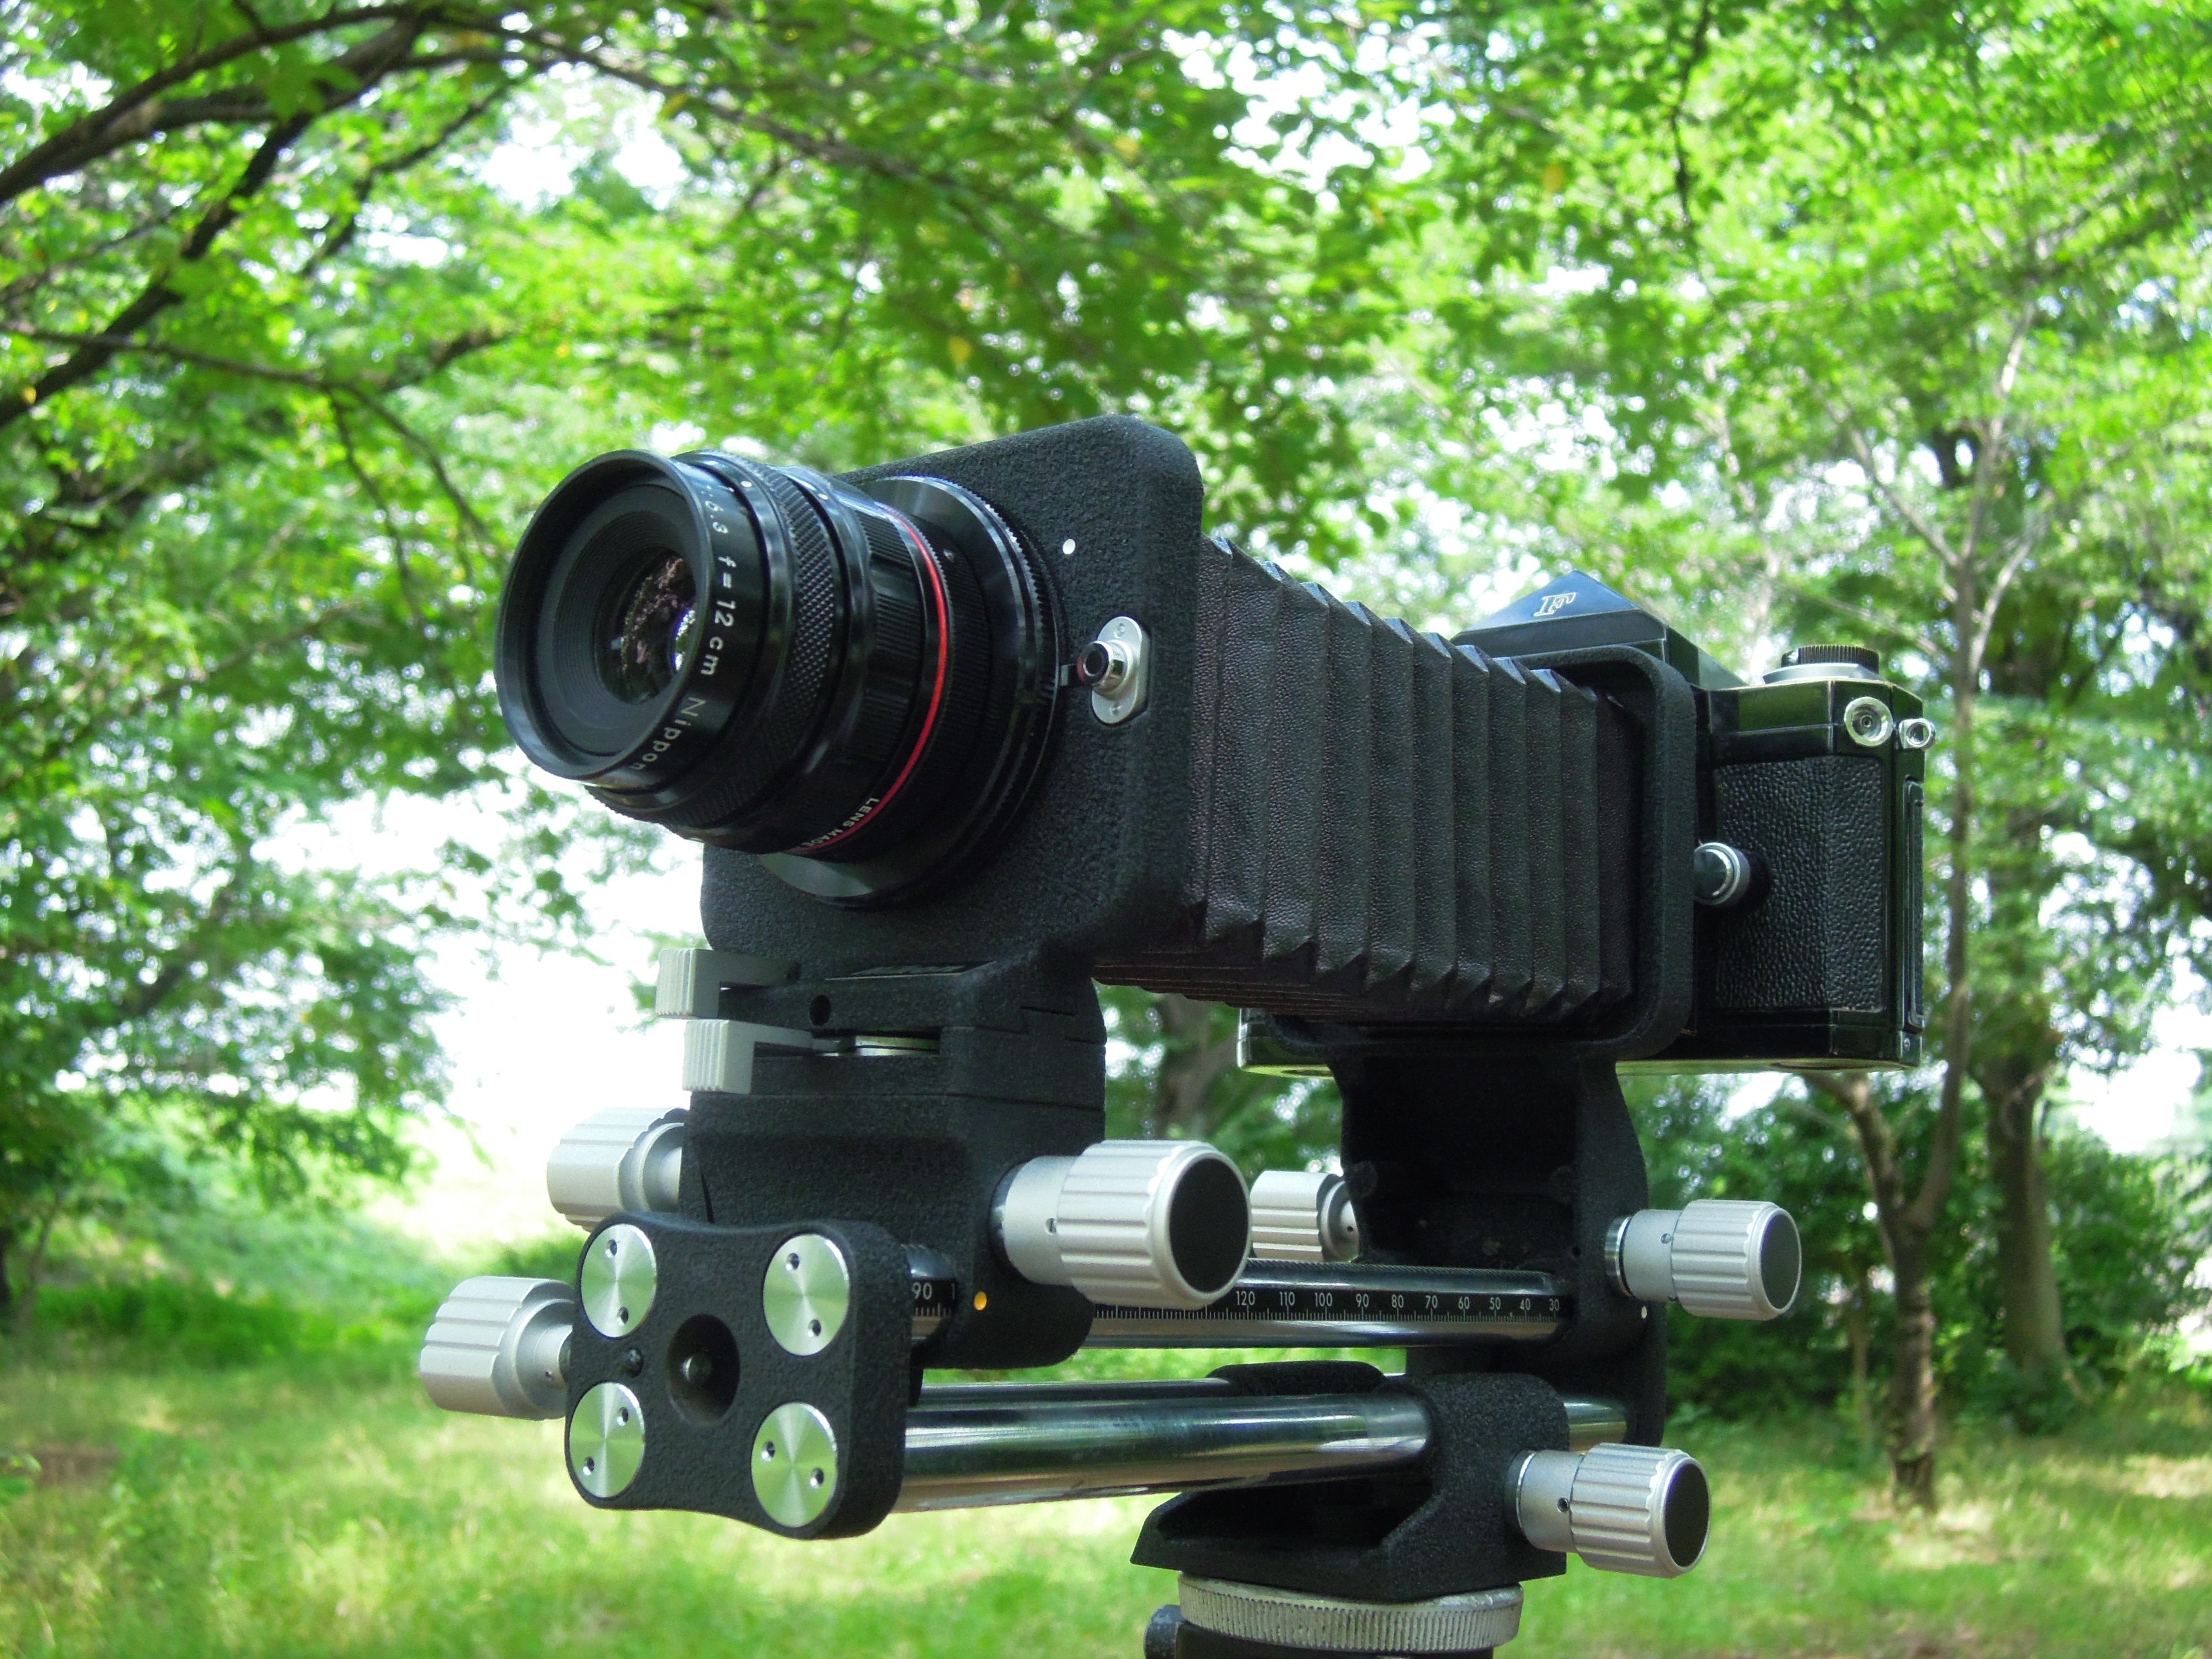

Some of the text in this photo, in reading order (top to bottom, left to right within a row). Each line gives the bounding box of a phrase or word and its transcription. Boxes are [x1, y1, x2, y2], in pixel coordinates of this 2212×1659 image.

[1533, 592, 1577, 617] F
[629, 696, 707, 770] Nippon
[842, 797, 880, 827] LENS
[1235, 1291, 1255, 1306] 120
[1279, 1291, 1295, 1306] 110
[1314, 1292, 1333, 1307] 100
[1355, 1293, 1369, 1308] 90
[1391, 1294, 1404, 1308] 80
[1425, 1295, 1438, 1309] 70
[1458, 1296, 1470, 1310] 60
[1489, 1297, 1501, 1310] 50
[1520, 1298, 1531, 1311] 40
[1549, 1298, 1559, 1311] 30
